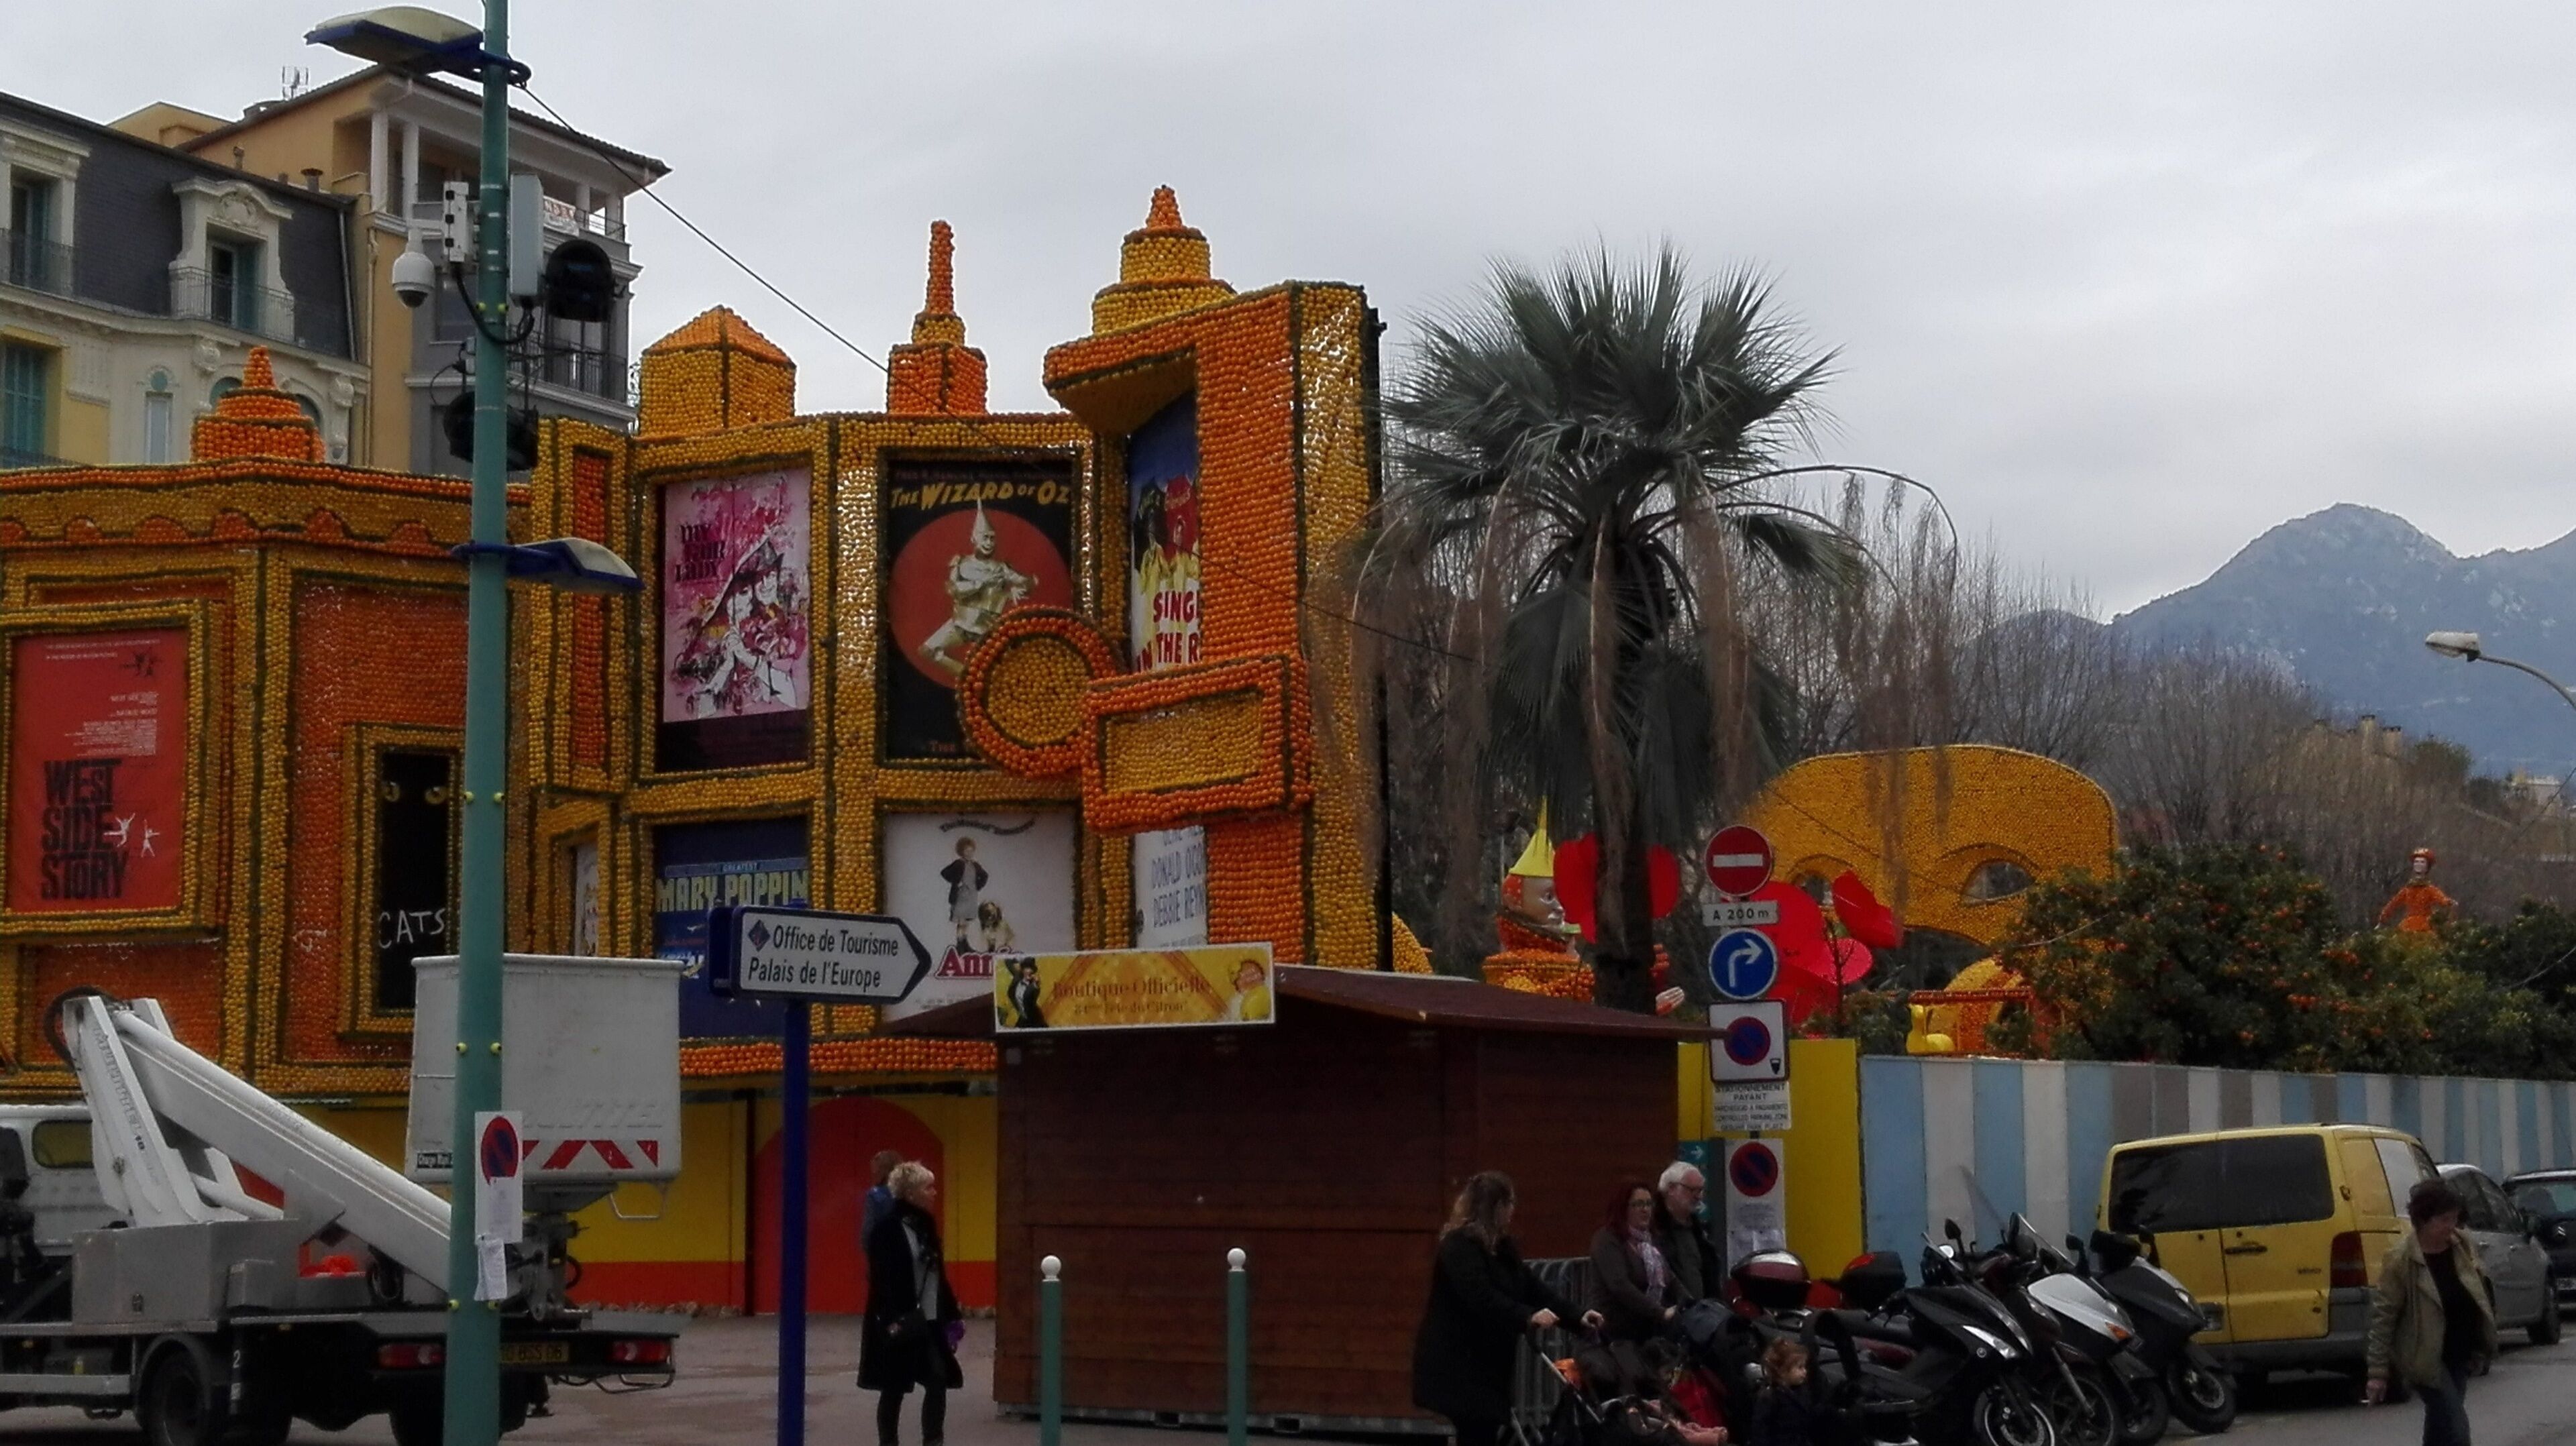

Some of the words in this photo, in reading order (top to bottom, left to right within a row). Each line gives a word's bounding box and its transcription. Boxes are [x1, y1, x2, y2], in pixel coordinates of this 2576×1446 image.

[892, 487, 919, 508] THE
[921, 482, 1014, 510] WIZARD
[1038, 479, 1070, 506] OZ
[1156, 632, 1182, 663] THE
[1188, 632, 1201, 663] R
[44, 759, 122, 805] WEST
[42, 805, 114, 853] SIDE
[42, 850, 129, 899] STORY
[656, 876, 718, 912] MARY
[724, 870, 810, 908] POPPIN
[379, 908, 445, 949] CATS
[1713, 909, 1721, 920] A
[1727, 908, 1754, 920] 200
[1758, 909, 1769, 917] m
[773, 925, 814, 951] Office
[818, 929, 835, 950] de
[840, 930, 898, 956] Tourisme
[748, 957, 794, 983] Palais
[800, 960, 817, 984] de
[822, 961, 881, 993] l'Europe
[934, 944, 994, 979] Ann
[1054, 981, 1131, 1001] Boutique
[232, 1349, 241, 1368] 2
